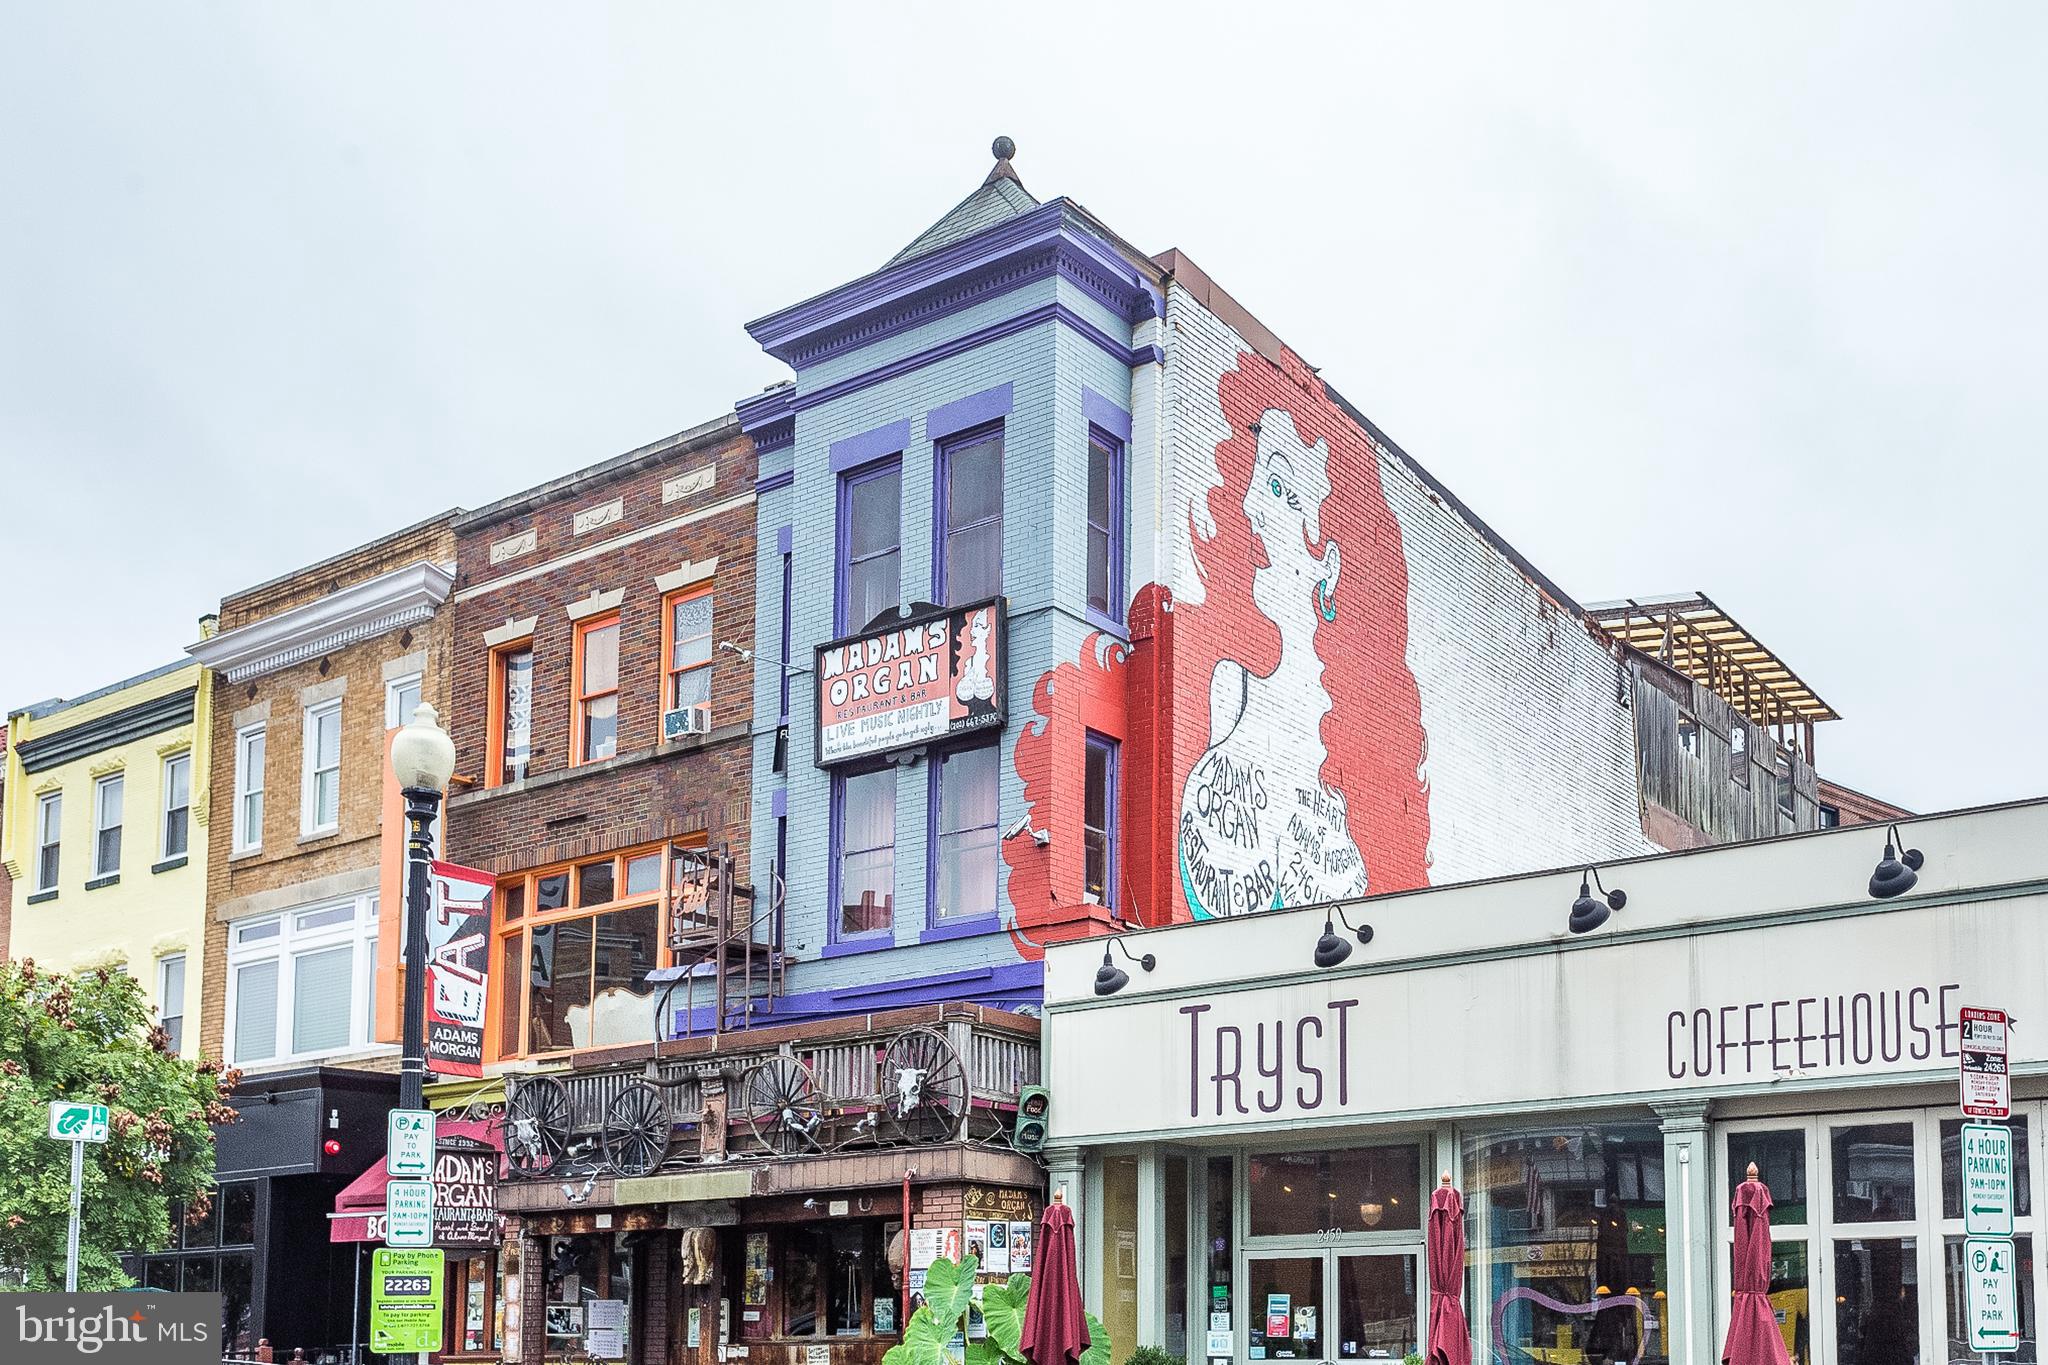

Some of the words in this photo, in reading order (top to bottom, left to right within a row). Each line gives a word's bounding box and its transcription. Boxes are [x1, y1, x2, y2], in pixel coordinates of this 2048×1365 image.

[823, 619, 948, 680] MADAM'S
[829, 653, 939, 707] ORGAN
[837, 696, 898, 719] RESTAURANT
[910, 689, 927, 701] BAR
[826, 722, 855, 741] LIVE
[861, 712, 894, 733] MUSIC
[897, 700, 943, 724] NIGHTLY
[1199, 752, 1268, 811] MADAM'S
[1197, 784, 1260, 850] ORGAN
[1295, 788, 1311, 808] THE
[1312, 789, 1346, 832] HEART
[1287, 812, 1321, 865] ADAMS
[1317, 826, 1327, 843] OF
[1324, 844, 1361, 877] MORGAN
[1243, 860, 1276, 912] BAR
[434, 880, 487, 1024] EAT
[1987, 1012, 2001, 1022] ZONE
[433, 1027, 479, 1045] ADAMS
[1667, 984, 1960, 1079] COFFEEHOUSE
[1963, 1021, 1970, 1037] 2
[1973, 1023, 1993, 1033] HOUR
[429, 1040, 481, 1059] MORGAN
[1179, 999, 1359, 1118] TRYST
[1984, 1062, 2006, 1073] 24263
[1967, 1138, 1974, 1154] 4
[1978, 1139, 2006, 1156] HOUR
[434, 1154, 494, 1184] ADAM'S
[1967, 1157, 2007, 1174] PARKING
[403, 1189, 426, 1197] HOUR
[1970, 1178, 2006, 1190] 9AM-10PM
[395, 1201, 426, 1209] PARKING
[433, 1207, 471, 1221] TAURANT
[476, 1207, 494, 1222] BAR
[1317, 1227, 1343, 1243] 2459
[385, 1279, 430, 1291] 22263
[1982, 1279, 1999, 1288] PAY
[1986, 1294, 1997, 1305] TO
[1981, 1310, 2004, 1321] PARK
